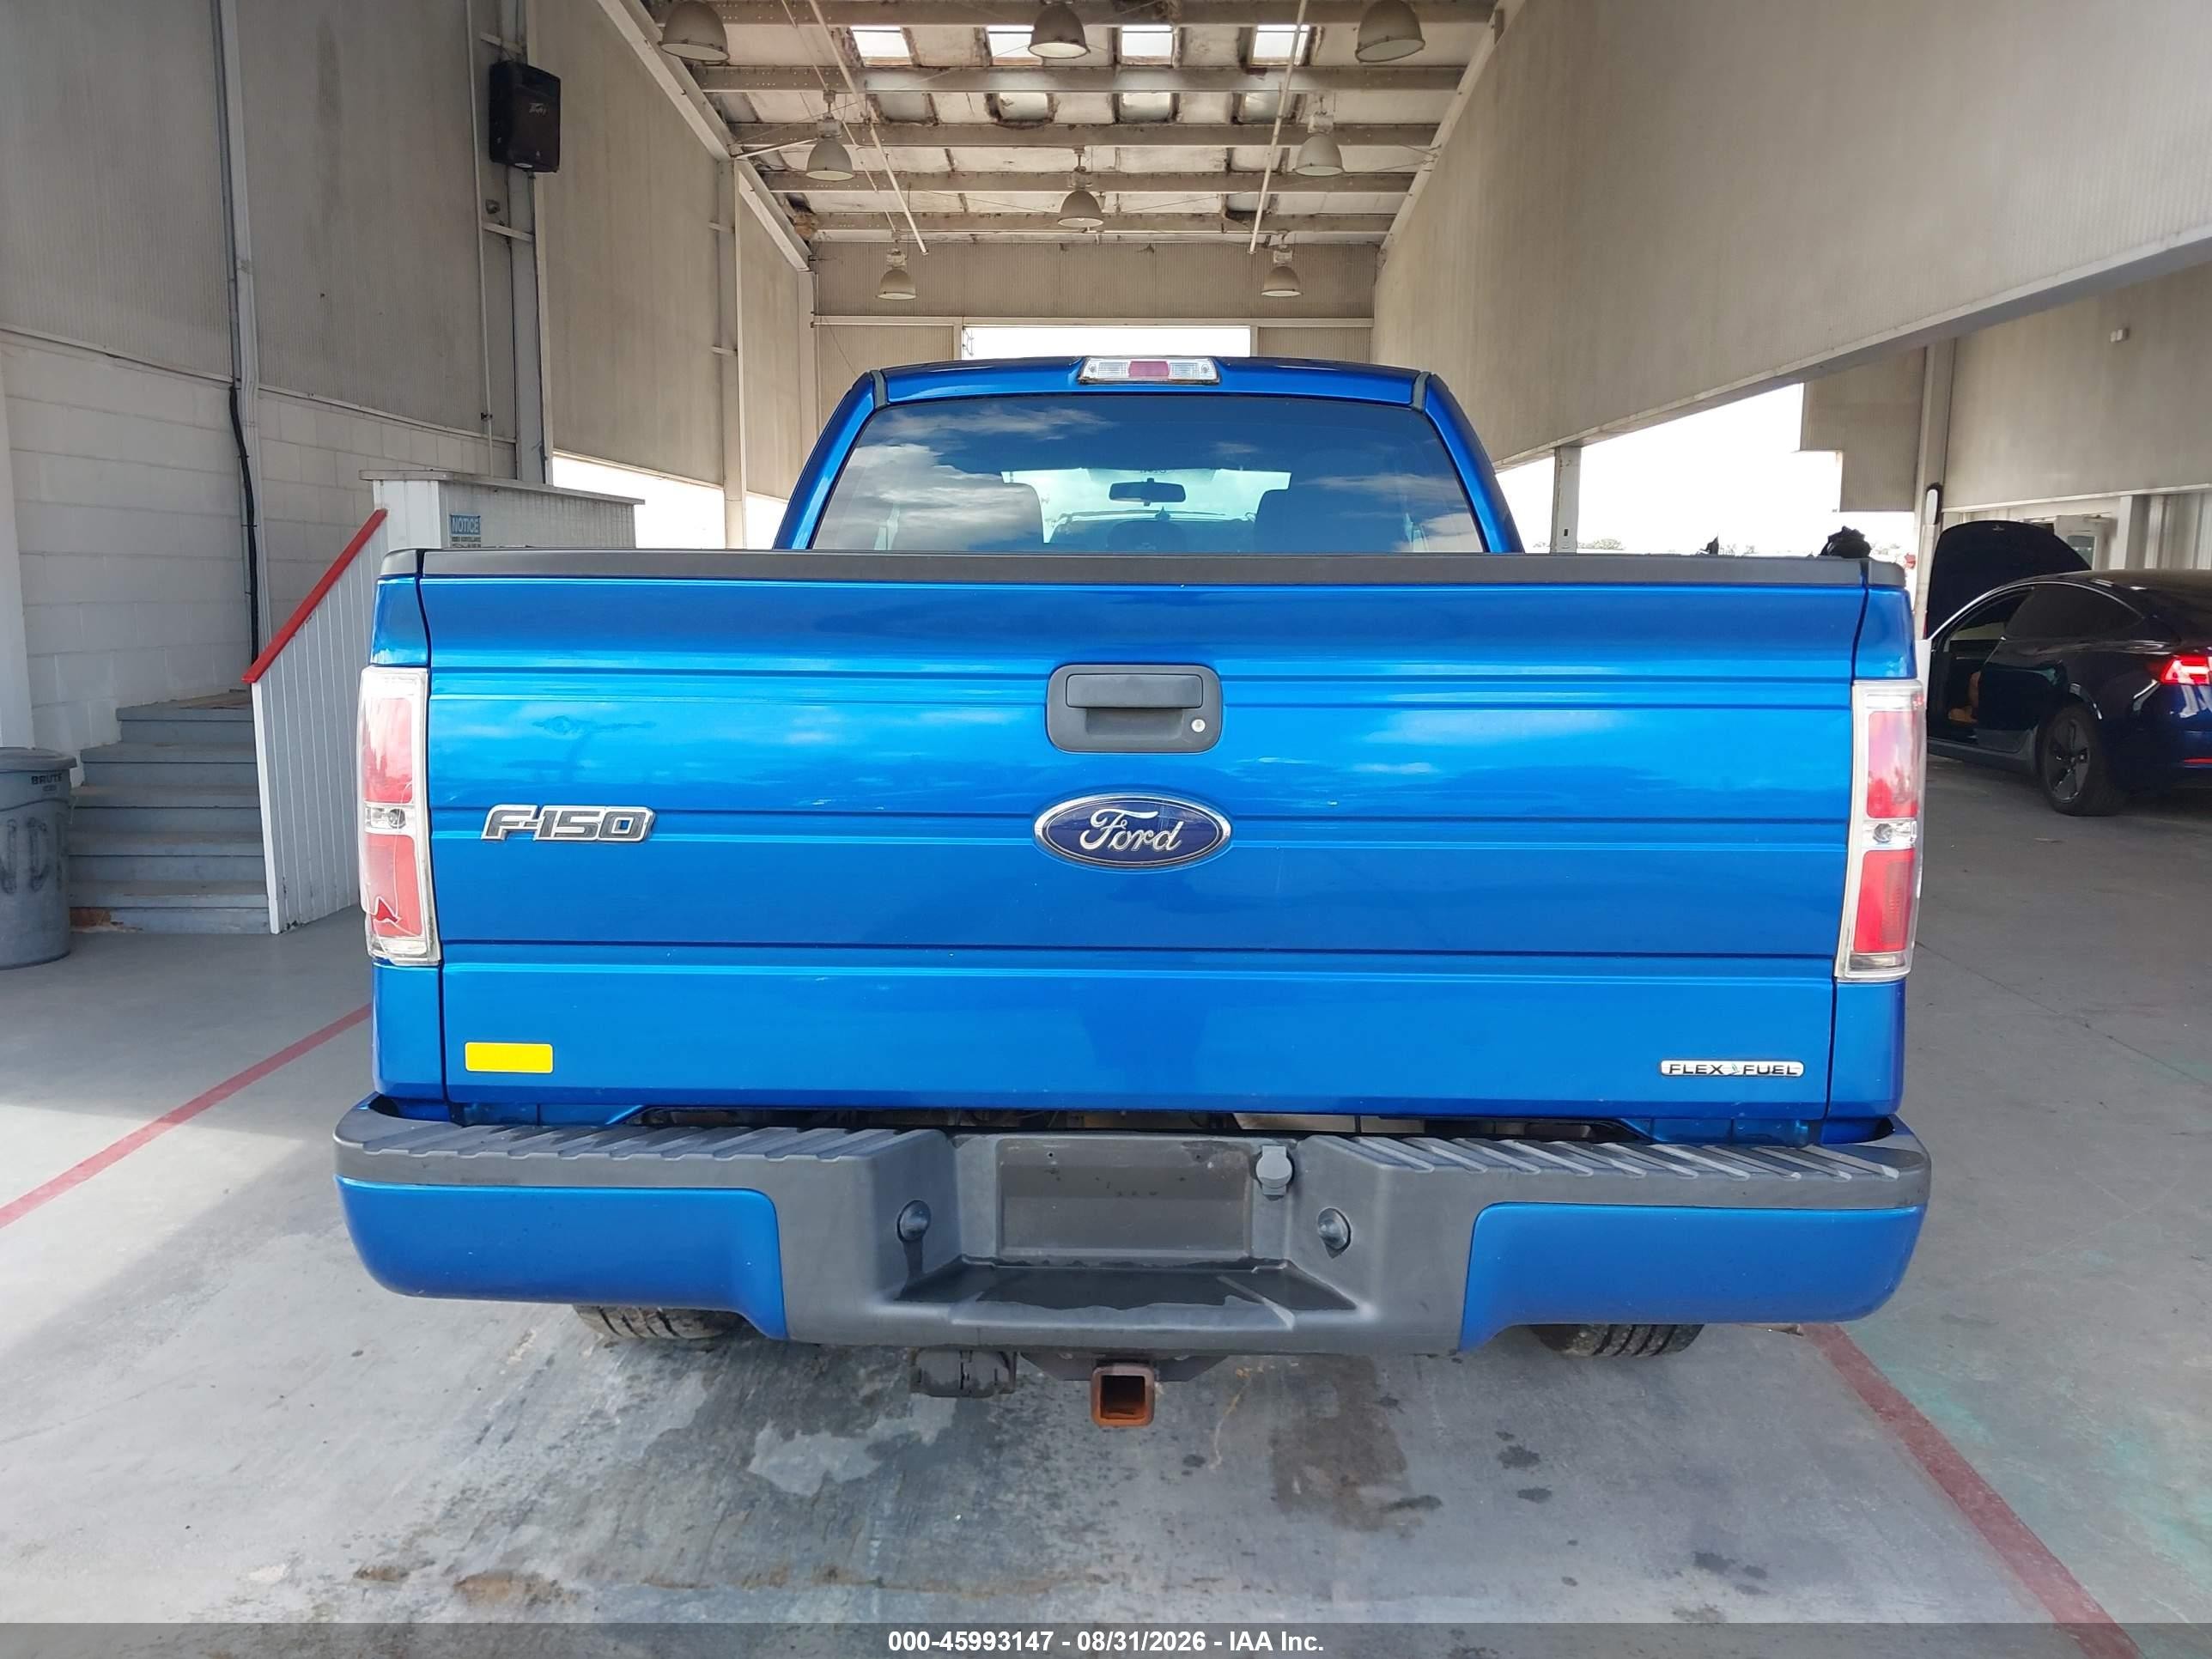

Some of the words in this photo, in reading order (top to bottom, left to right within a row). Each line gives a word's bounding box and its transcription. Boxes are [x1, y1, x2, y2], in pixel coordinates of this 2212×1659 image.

[452, 517, 480, 532] NOTICE
[31, 773, 63, 785] BRUTE
[481, 804, 655, 842] F-150
[1079, 808, 1184, 852] Ford
[1668, 1064, 1724, 1075] FLEX
[1742, 1065, 1798, 1075] FUEL
